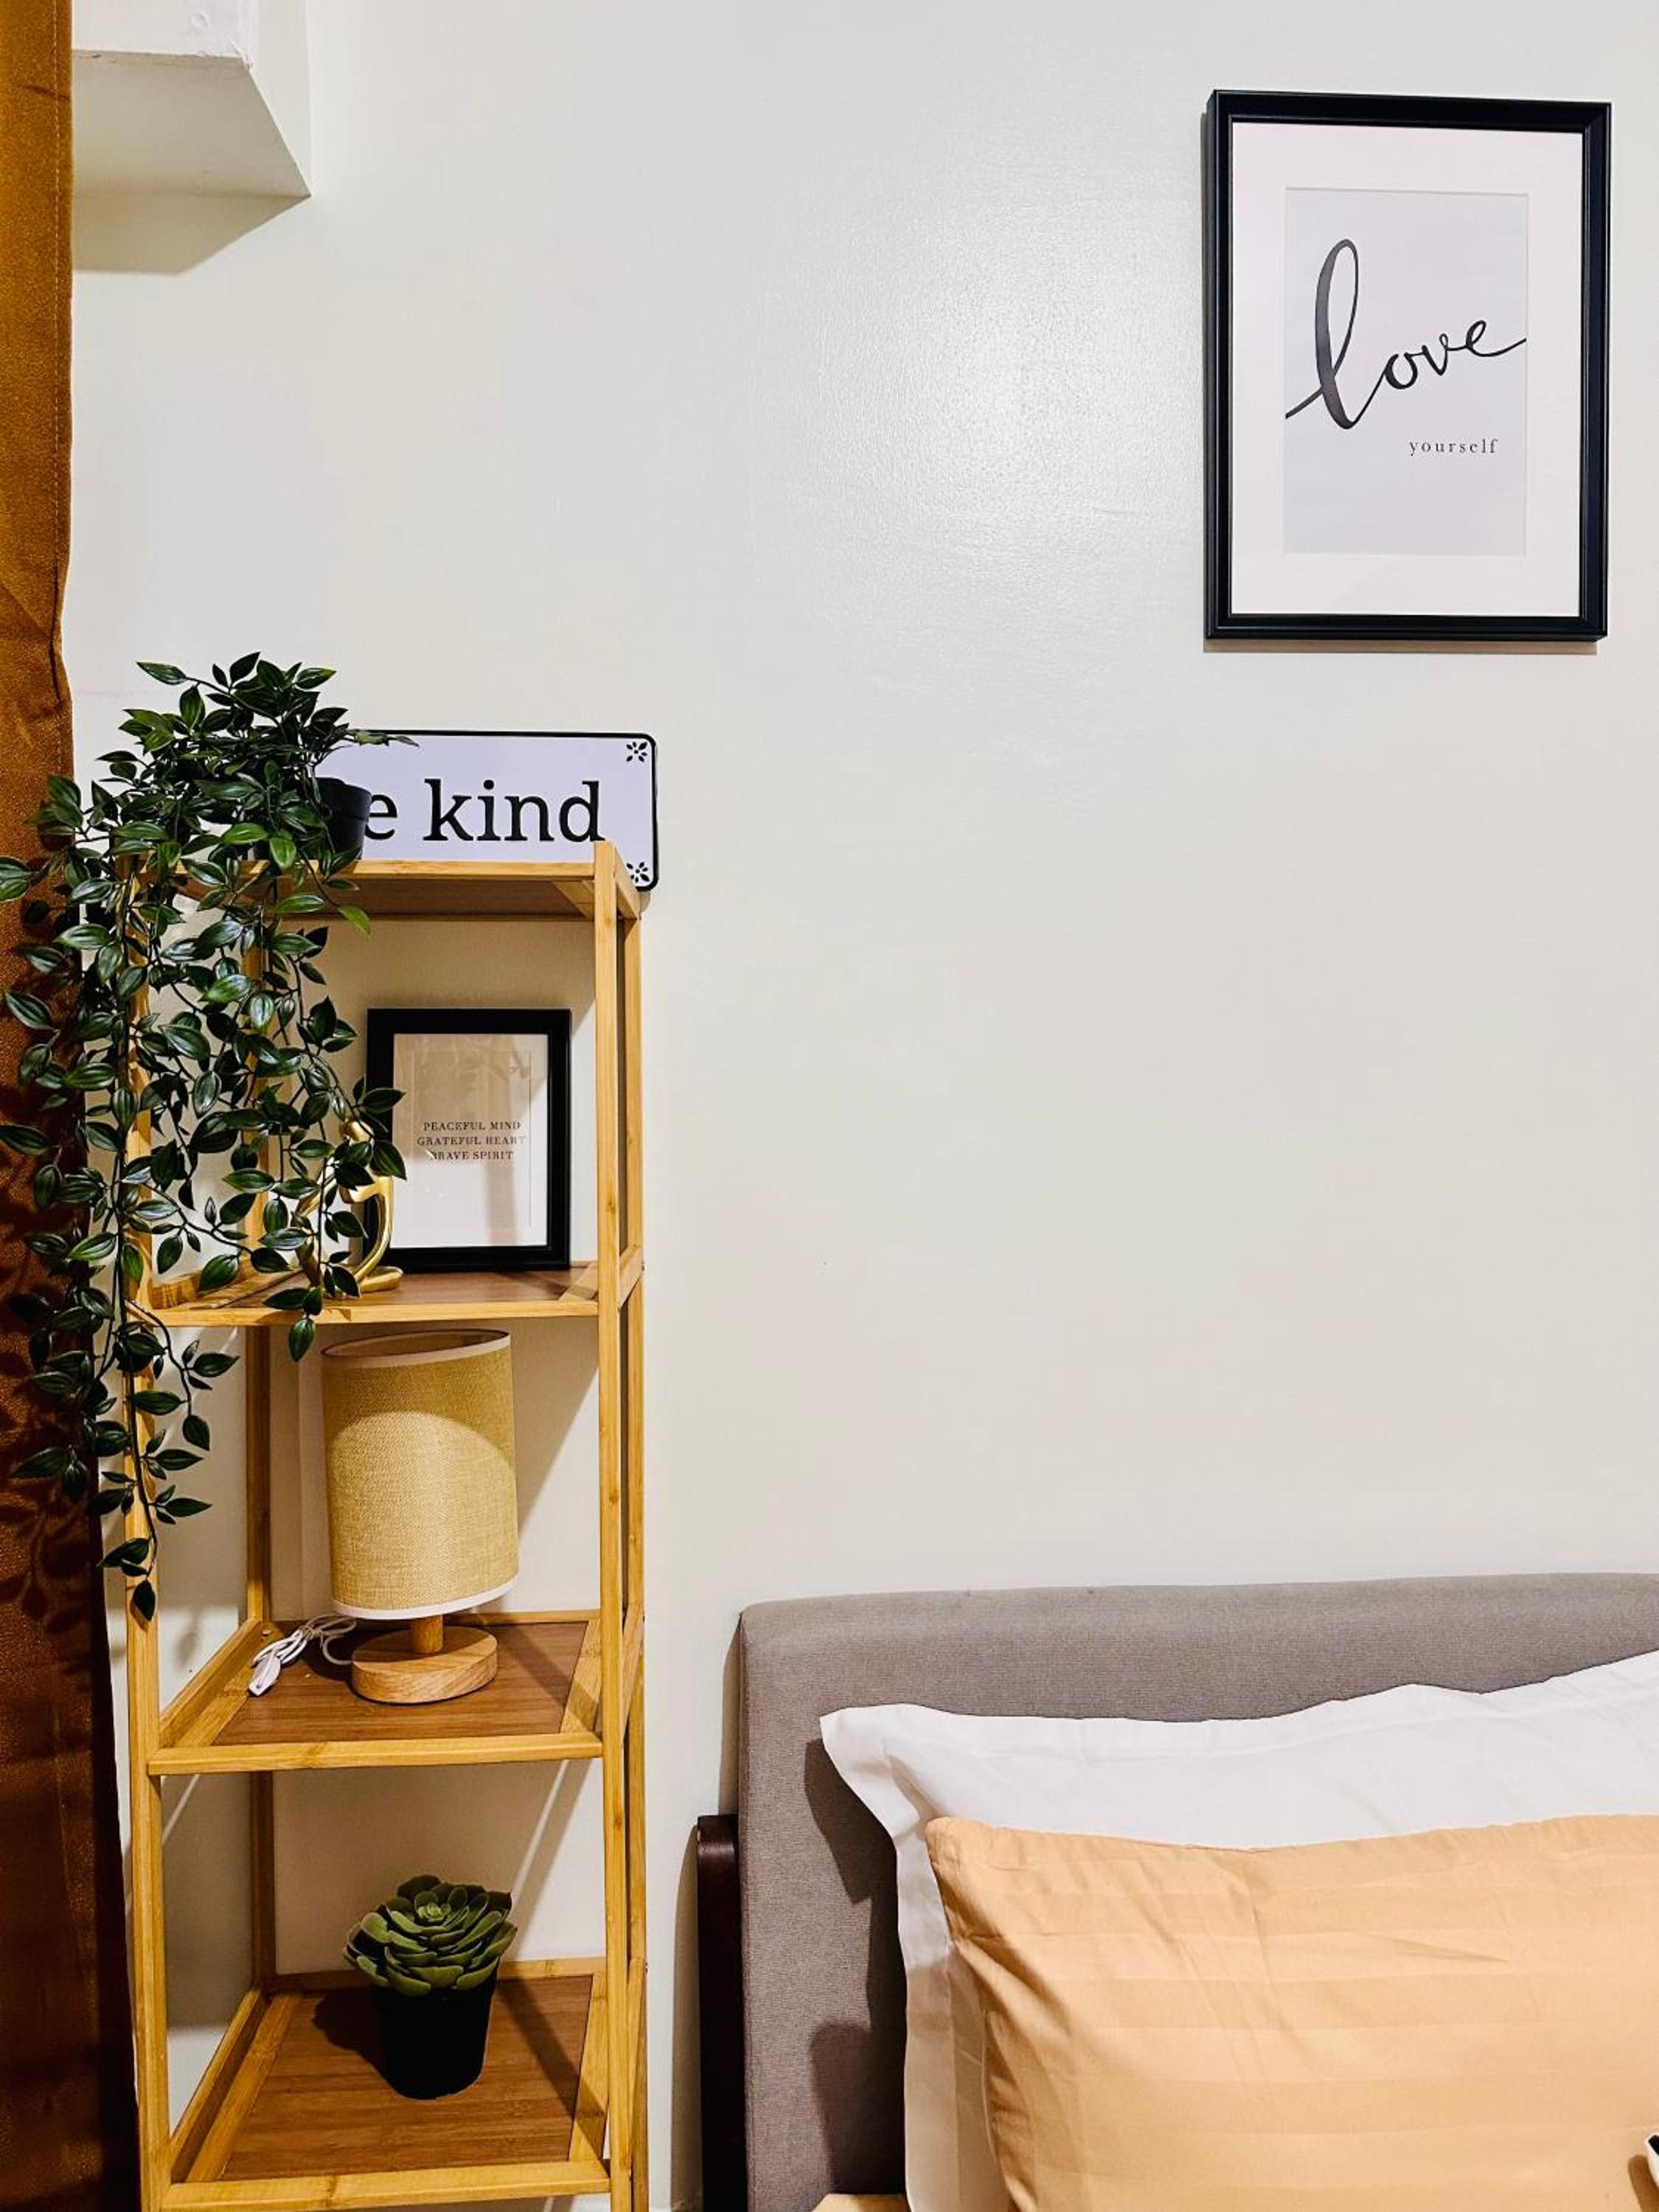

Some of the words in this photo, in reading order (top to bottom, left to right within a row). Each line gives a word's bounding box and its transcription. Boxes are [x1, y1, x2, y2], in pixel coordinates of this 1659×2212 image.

[1285, 239, 1526, 429] love
[1409, 438, 1498, 457] yourself
[364, 793, 398, 841] e
[423, 779, 605, 842] kind
[423, 1121, 486, 1131] PEACEFUL
[489, 1121, 521, 1130] MIND
[417, 1135, 481, 1146] GRATEFUL
[485, 1135, 526, 1145] HEART
[473, 1150, 513, 1160] SPIRIT
